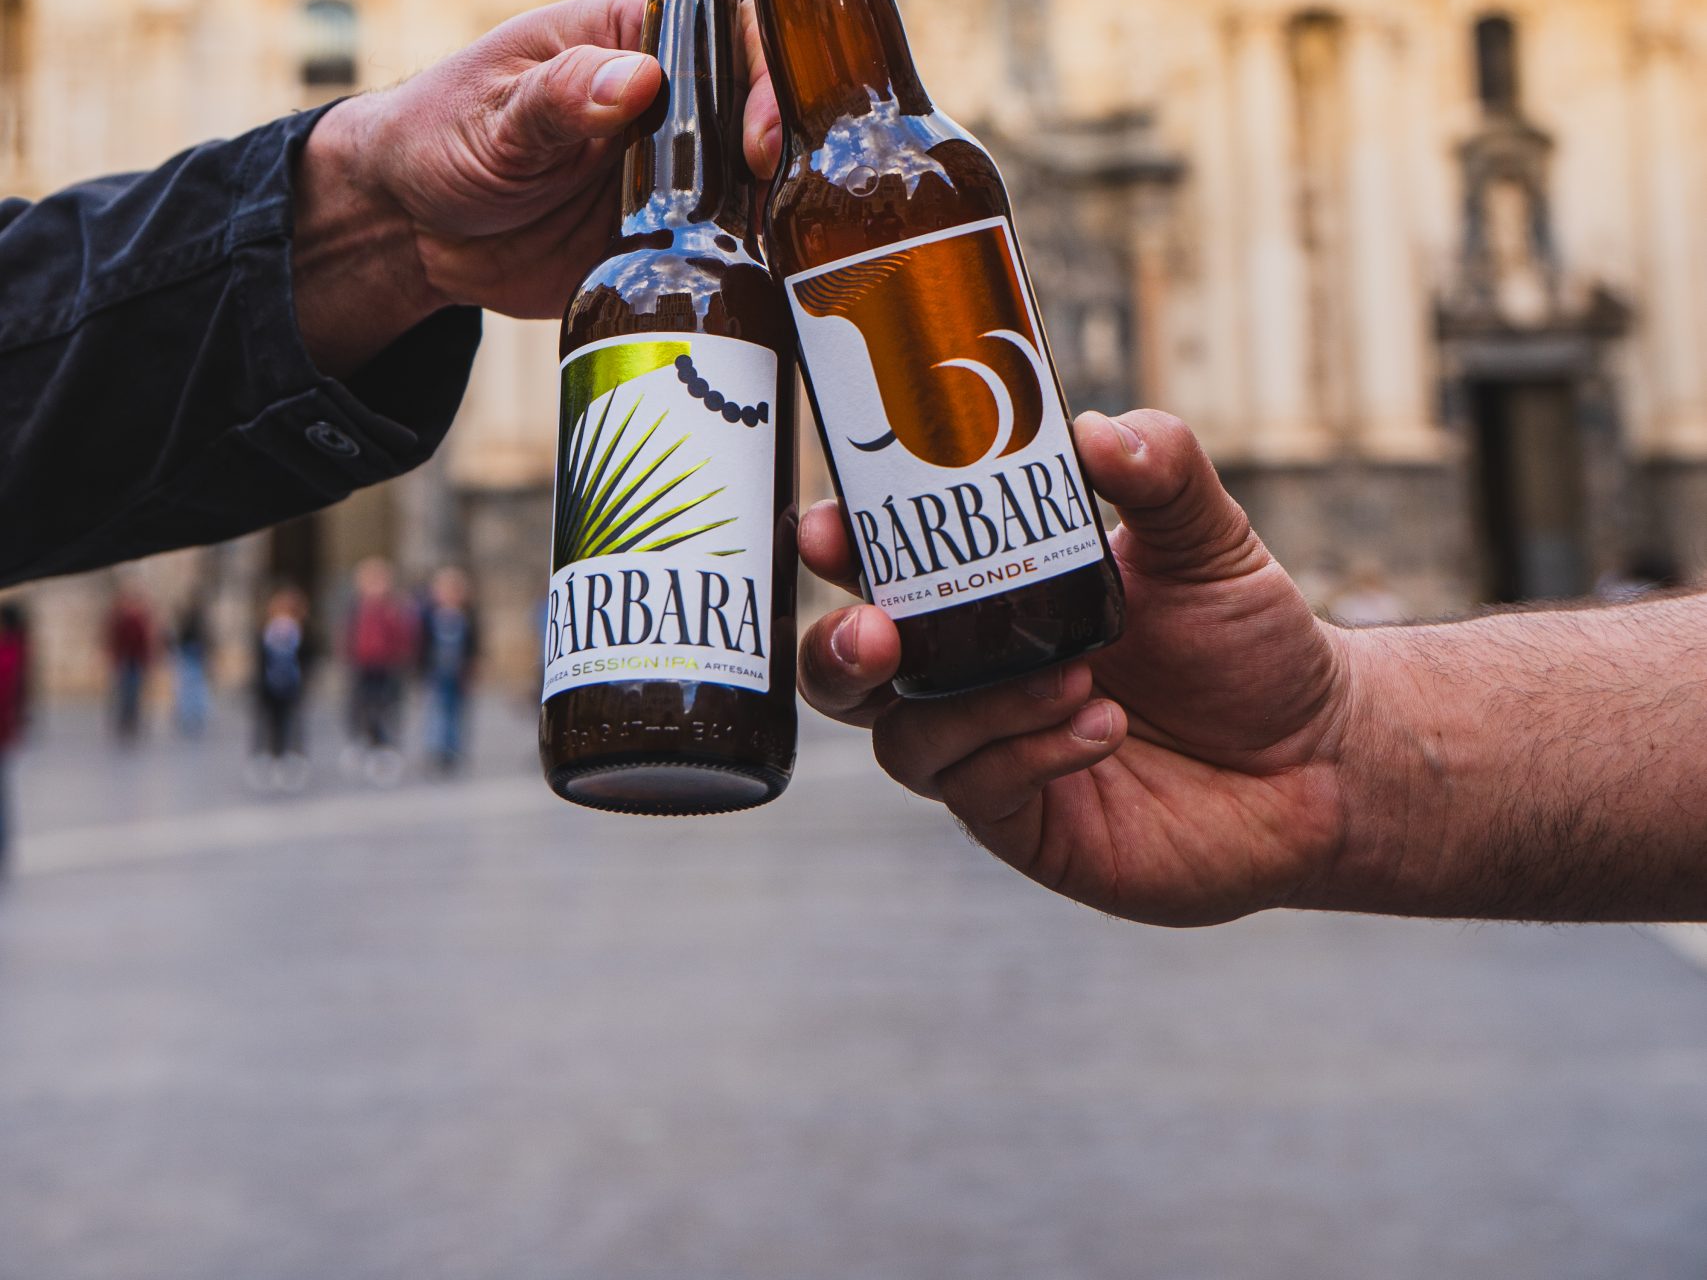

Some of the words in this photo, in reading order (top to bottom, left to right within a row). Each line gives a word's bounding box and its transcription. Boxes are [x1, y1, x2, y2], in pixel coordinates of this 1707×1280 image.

[853, 453, 1092, 586] BÁRBARA
[880, 589, 933, 607] CERVEZA
[936, 557, 1038, 597] BLONDE
[1043, 539, 1097, 564] ARTESANA
[547, 568, 766, 668] BÁRBARA
[572, 656, 659, 677] SESSION
[665, 656, 699, 670] IPA
[704, 662, 764, 680] ARTESANA
